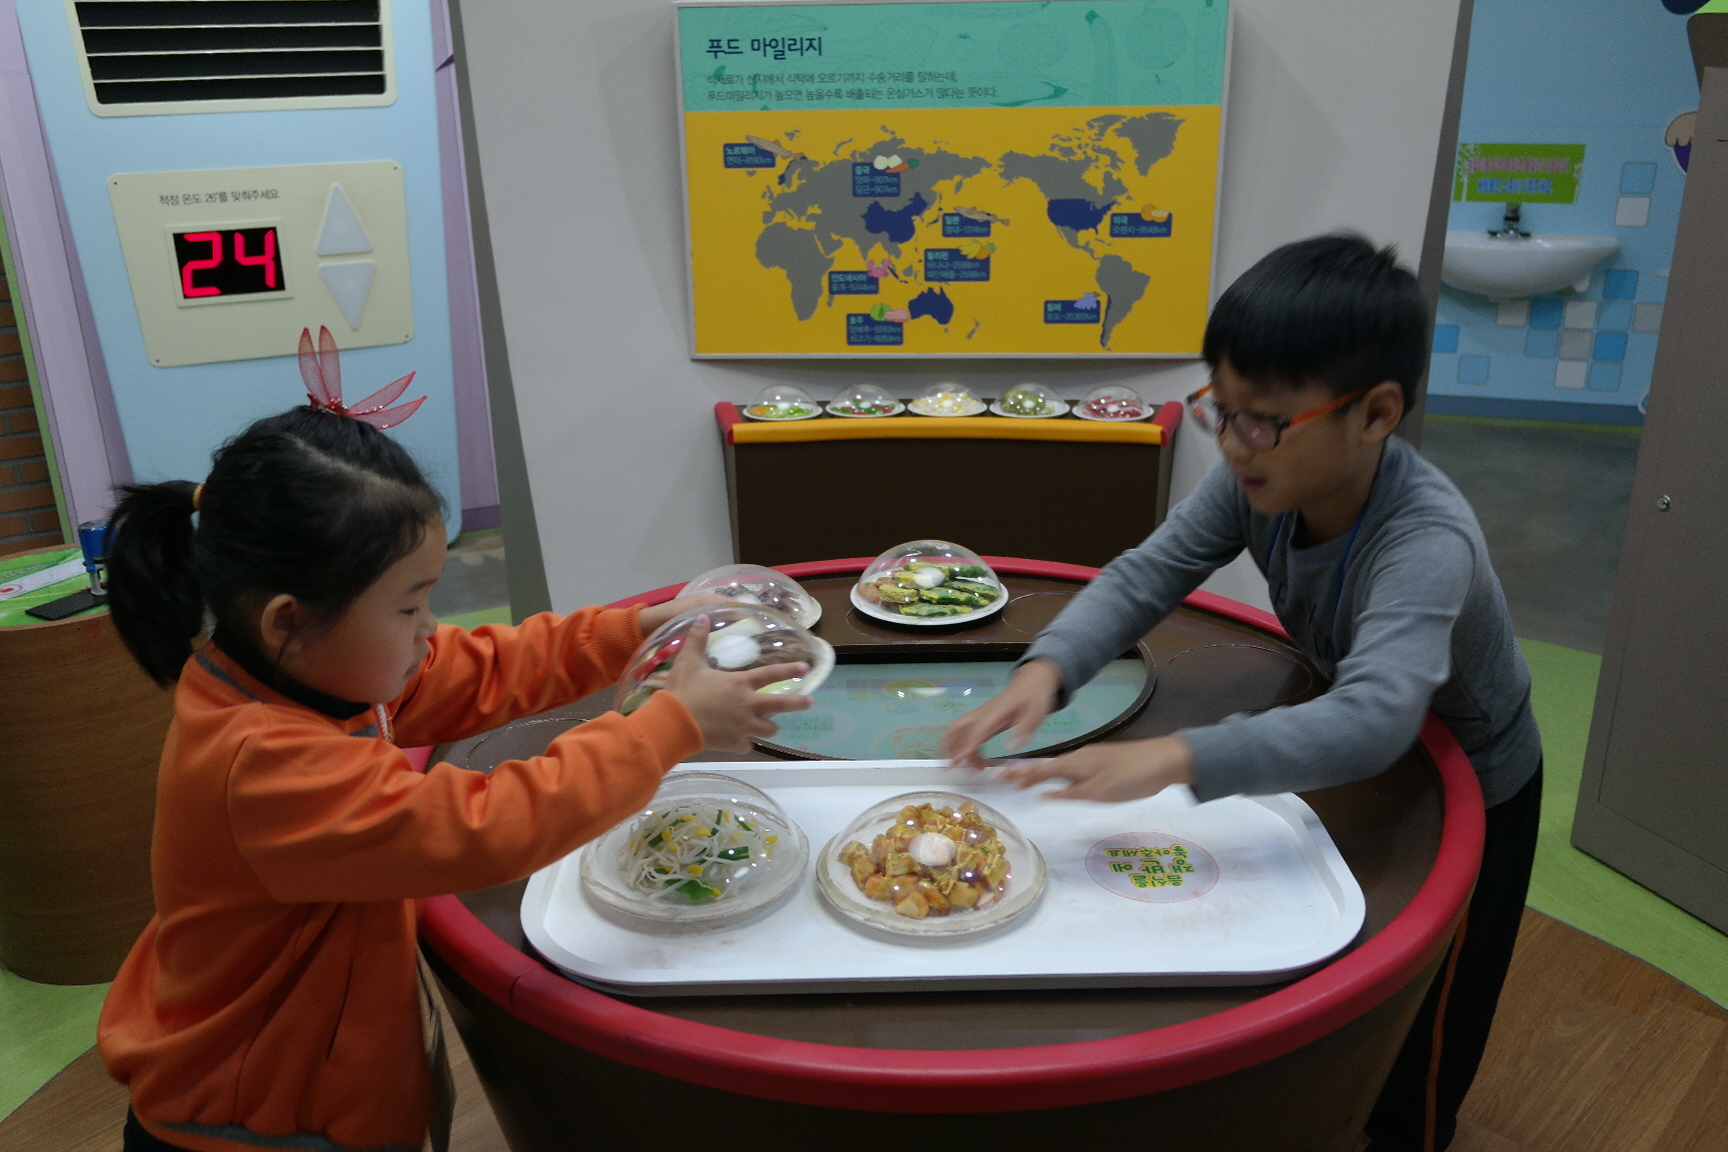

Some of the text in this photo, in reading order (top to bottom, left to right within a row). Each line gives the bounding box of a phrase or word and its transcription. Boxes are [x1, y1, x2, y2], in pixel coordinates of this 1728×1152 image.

[705, 36, 822, 60] 푸드 마일리지
[787, 73, 815, 84] 식탁에
[817, 71, 864, 84] 오르기까지
[867, 71, 914, 84] 수송거리를
[706, 90, 772, 102] 푸드마일리지가
[774, 89, 803, 101] 높으면
[806, 88, 843, 101] 높을수록
[845, 88, 883, 100] 배출되는
[886, 87, 934, 100] 온실가스가
[936, 87, 965, 99] 많다는
[159, 194, 180, 206] 적정
[182, 193, 202, 206] 온도
[230, 188, 280, 203] 맞춰주세요
[181, 229, 276, 298] 24
[1107, 845, 1188, 858] 놓아주세요
[1131, 874, 1183, 889] 음식을
